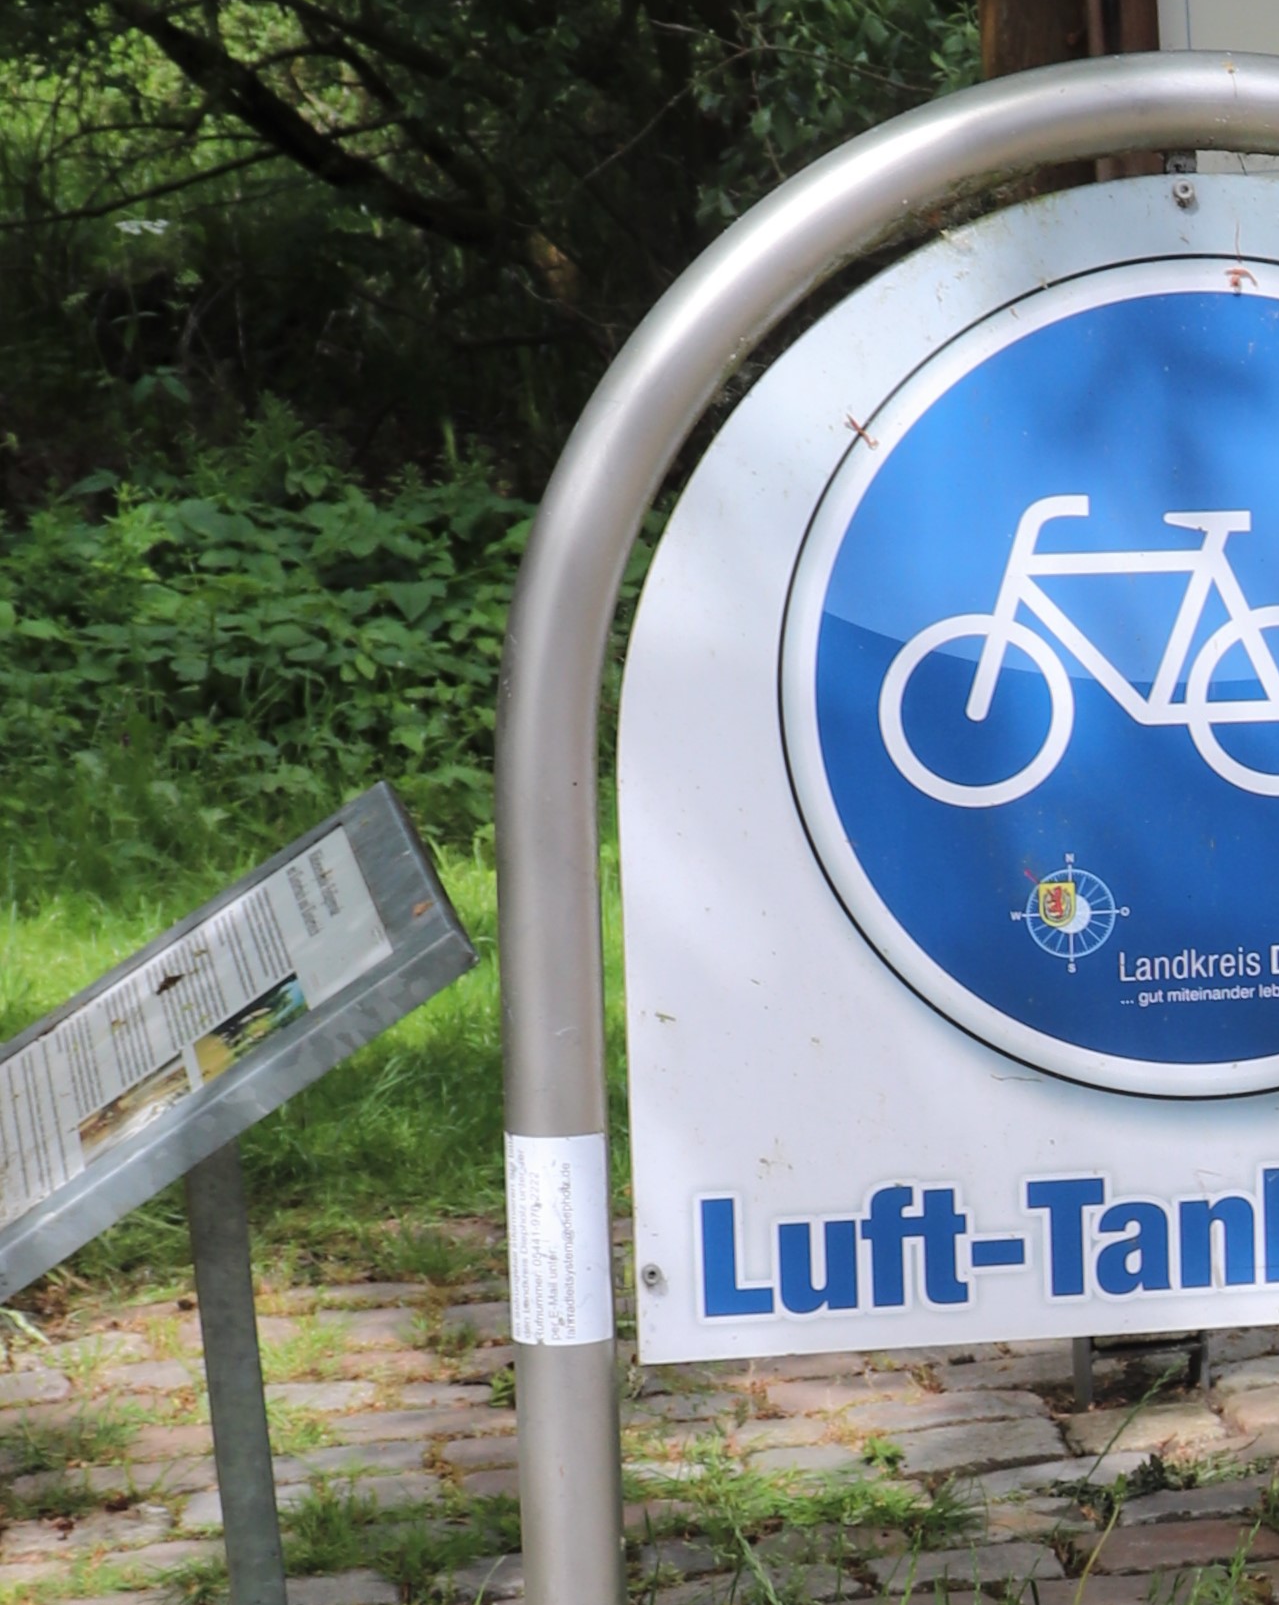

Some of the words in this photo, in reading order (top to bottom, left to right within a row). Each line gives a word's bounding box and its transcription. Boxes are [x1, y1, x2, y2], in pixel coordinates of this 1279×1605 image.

[1065, 853, 1075, 864] N
[1010, 910, 1023, 922] W
[1119, 906, 1130, 918] O
[1067, 962, 1077, 975] S
[1118, 947, 1261, 983] Landkreis
[1138, 989, 1164, 1008] gut
[1167, 984, 1256, 1003] miteinander
